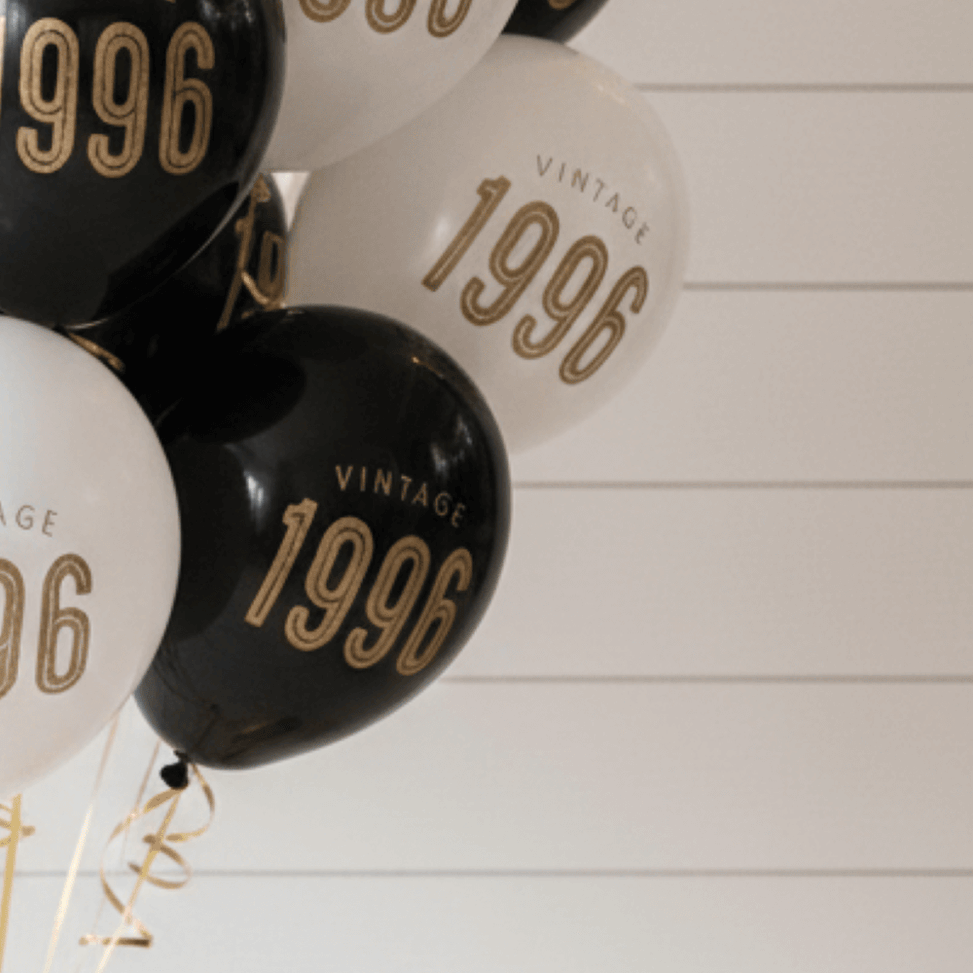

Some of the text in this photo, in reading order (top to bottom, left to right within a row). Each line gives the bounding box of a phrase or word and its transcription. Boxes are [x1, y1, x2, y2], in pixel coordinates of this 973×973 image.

[535, 154, 649, 246] VINTAGE
[422, 175, 648, 385] 1996
[336, 465, 467, 526] VINTAGE
[244, 498, 473, 676] 1996
